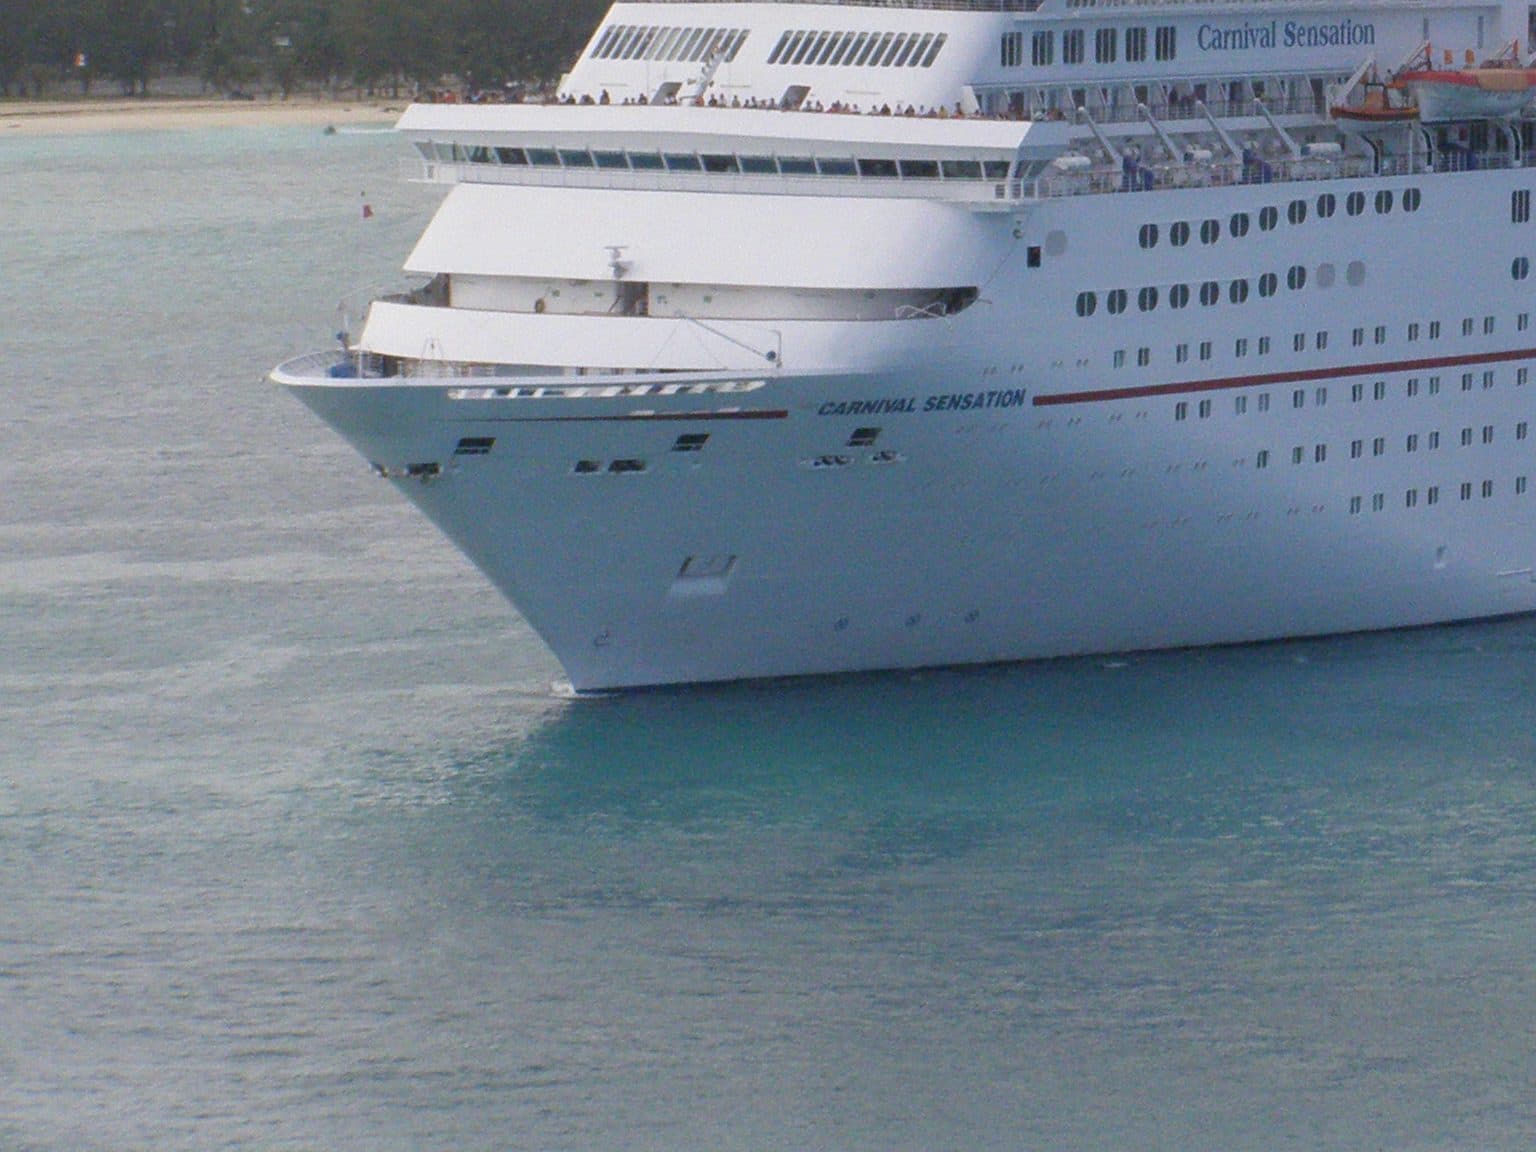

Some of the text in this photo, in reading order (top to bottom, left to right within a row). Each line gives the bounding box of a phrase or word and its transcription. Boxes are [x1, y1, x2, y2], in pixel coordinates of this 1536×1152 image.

[1197, 19, 1375, 50] Carnival Sensation
[818, 389, 1026, 416] CARNIVAL SENSATION
